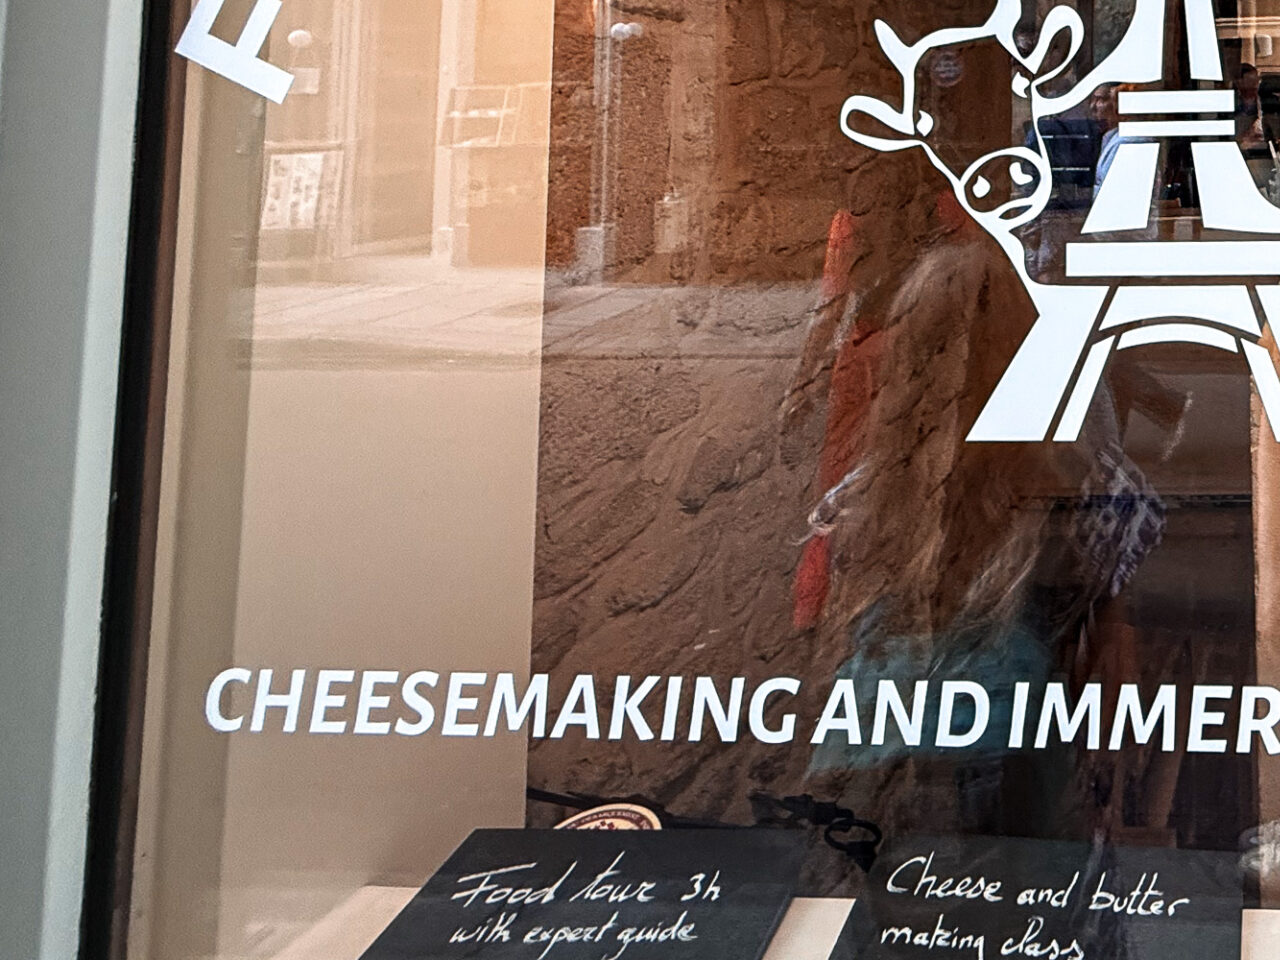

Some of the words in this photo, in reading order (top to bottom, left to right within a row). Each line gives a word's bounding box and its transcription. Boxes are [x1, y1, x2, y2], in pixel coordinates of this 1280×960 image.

[205, 667, 801, 745] CHEESEMAKING
[811, 679, 990, 747] AND
[450, 859, 577, 907] Food
[571, 849, 656, 904] tour
[680, 868, 722, 904] 3h
[886, 850, 1004, 904] Cheese
[1016, 871, 1081, 909] and
[1090, 871, 1191, 918] butter
[449, 911, 511, 945] with
[523, 910, 616, 959] expert
[617, 910, 699, 960] guide
[880, 913, 986, 960] making
[1000, 915, 1085, 960] class
